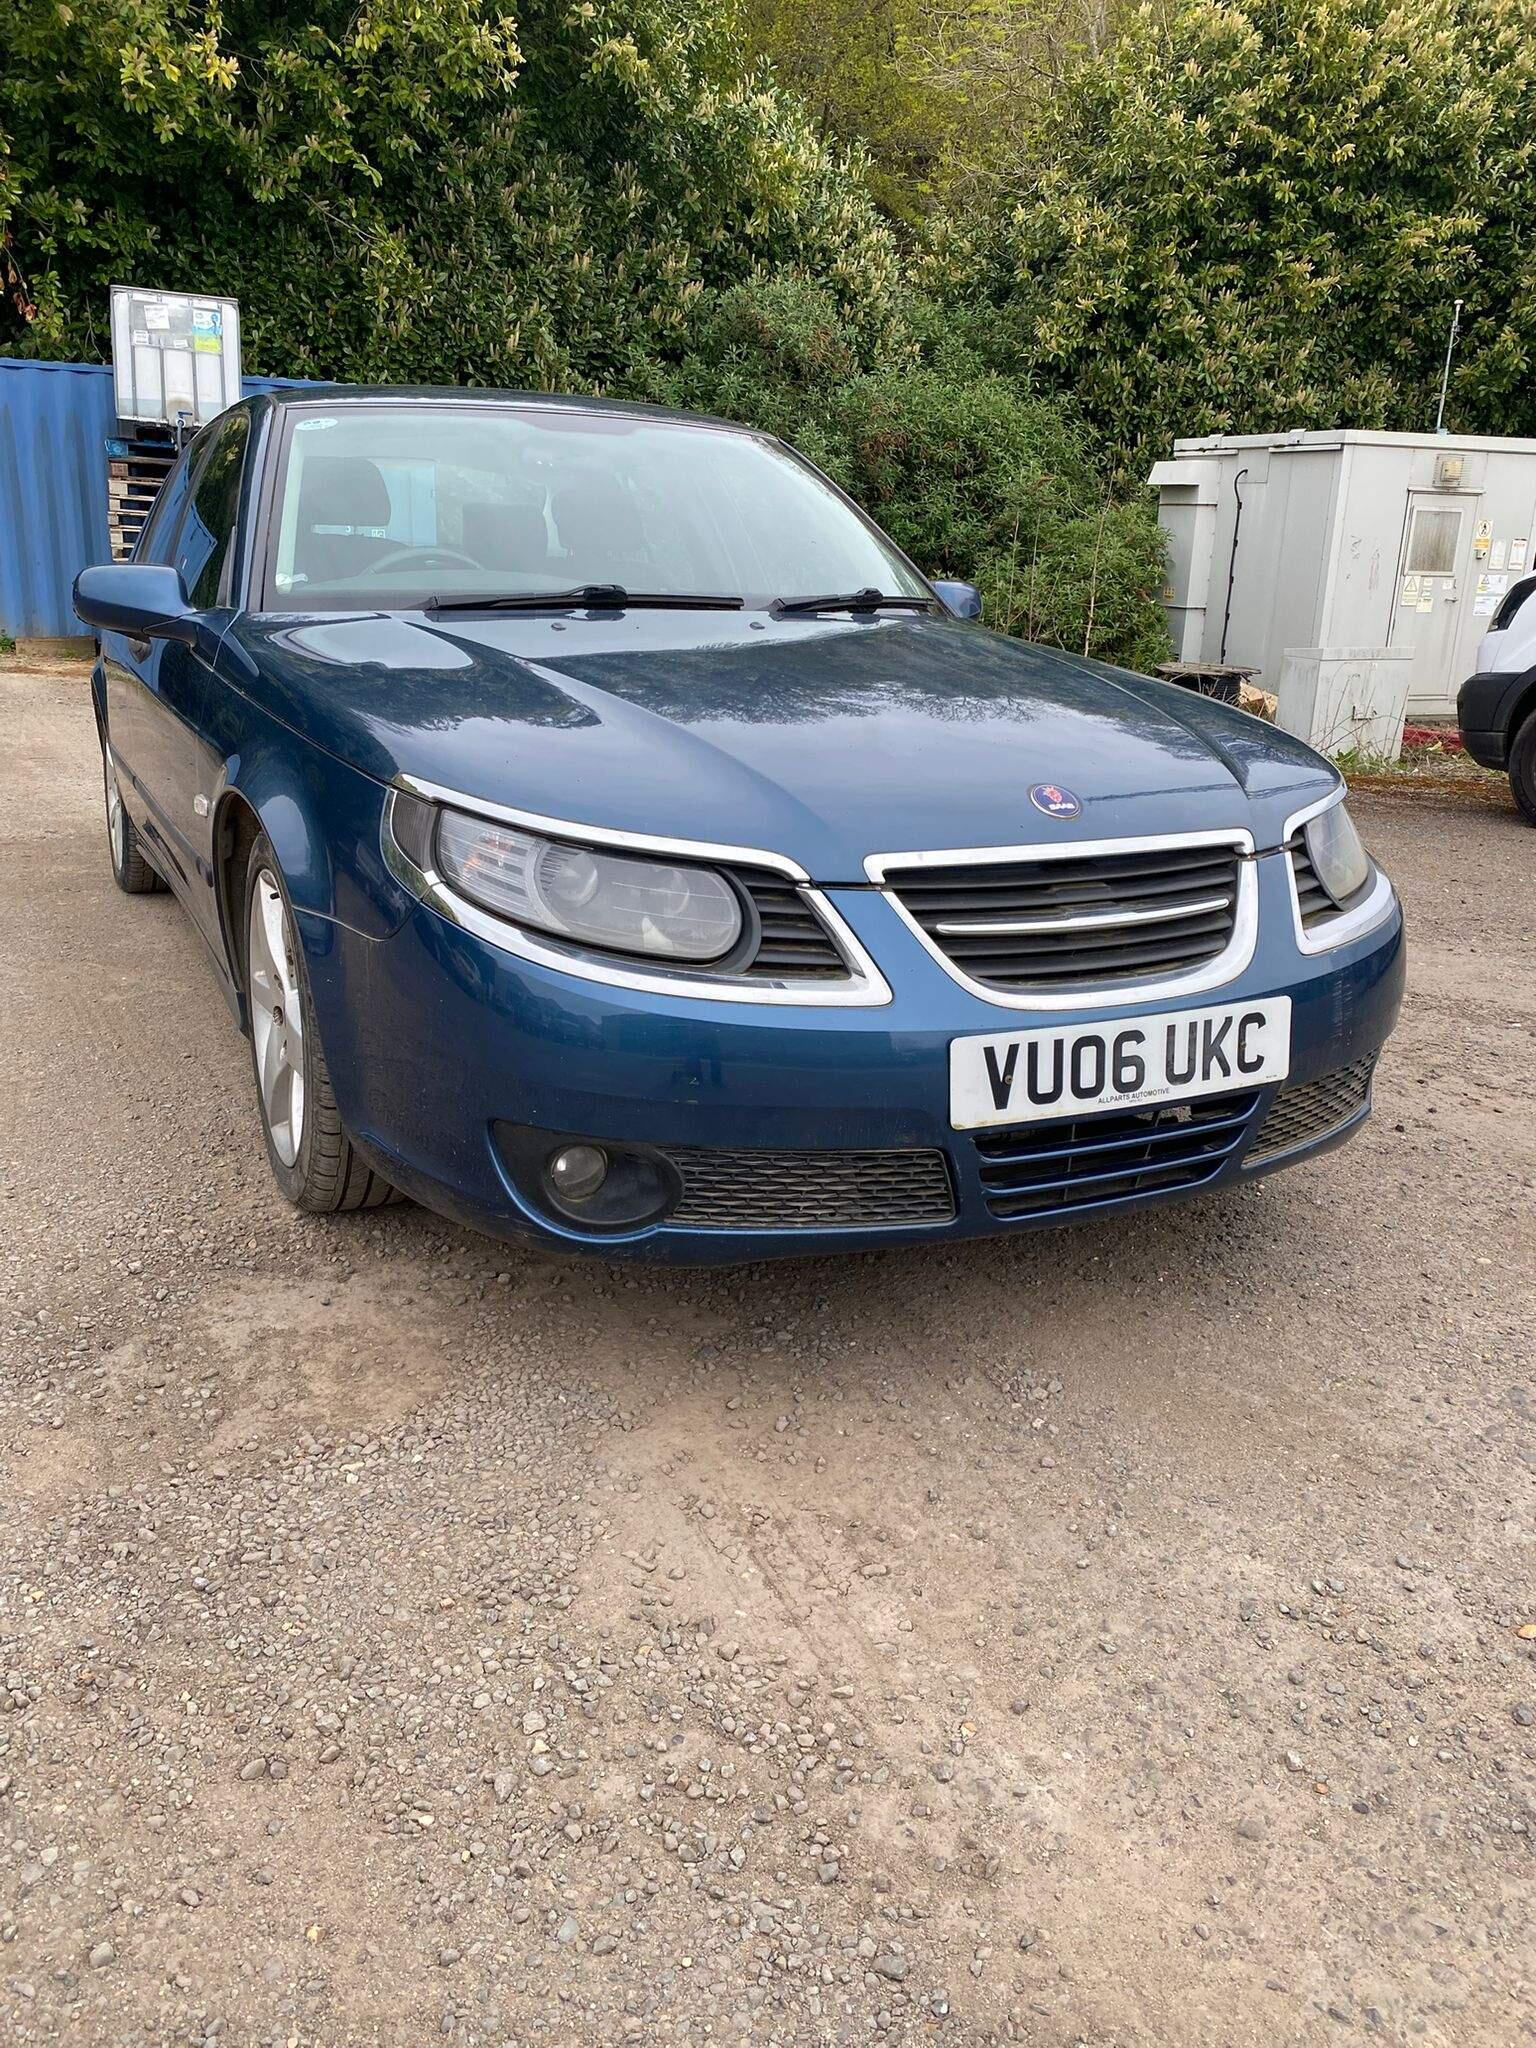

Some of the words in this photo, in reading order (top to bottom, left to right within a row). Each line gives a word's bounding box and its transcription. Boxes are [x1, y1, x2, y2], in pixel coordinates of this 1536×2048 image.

[983, 1029, 1146, 1111] VU06
[1165, 1012, 1267, 1086] UKC
[1098, 1094, 1131, 1104] ALLPARTS
[1131, 1087, 1170, 1099] AUTOMOTIVE
